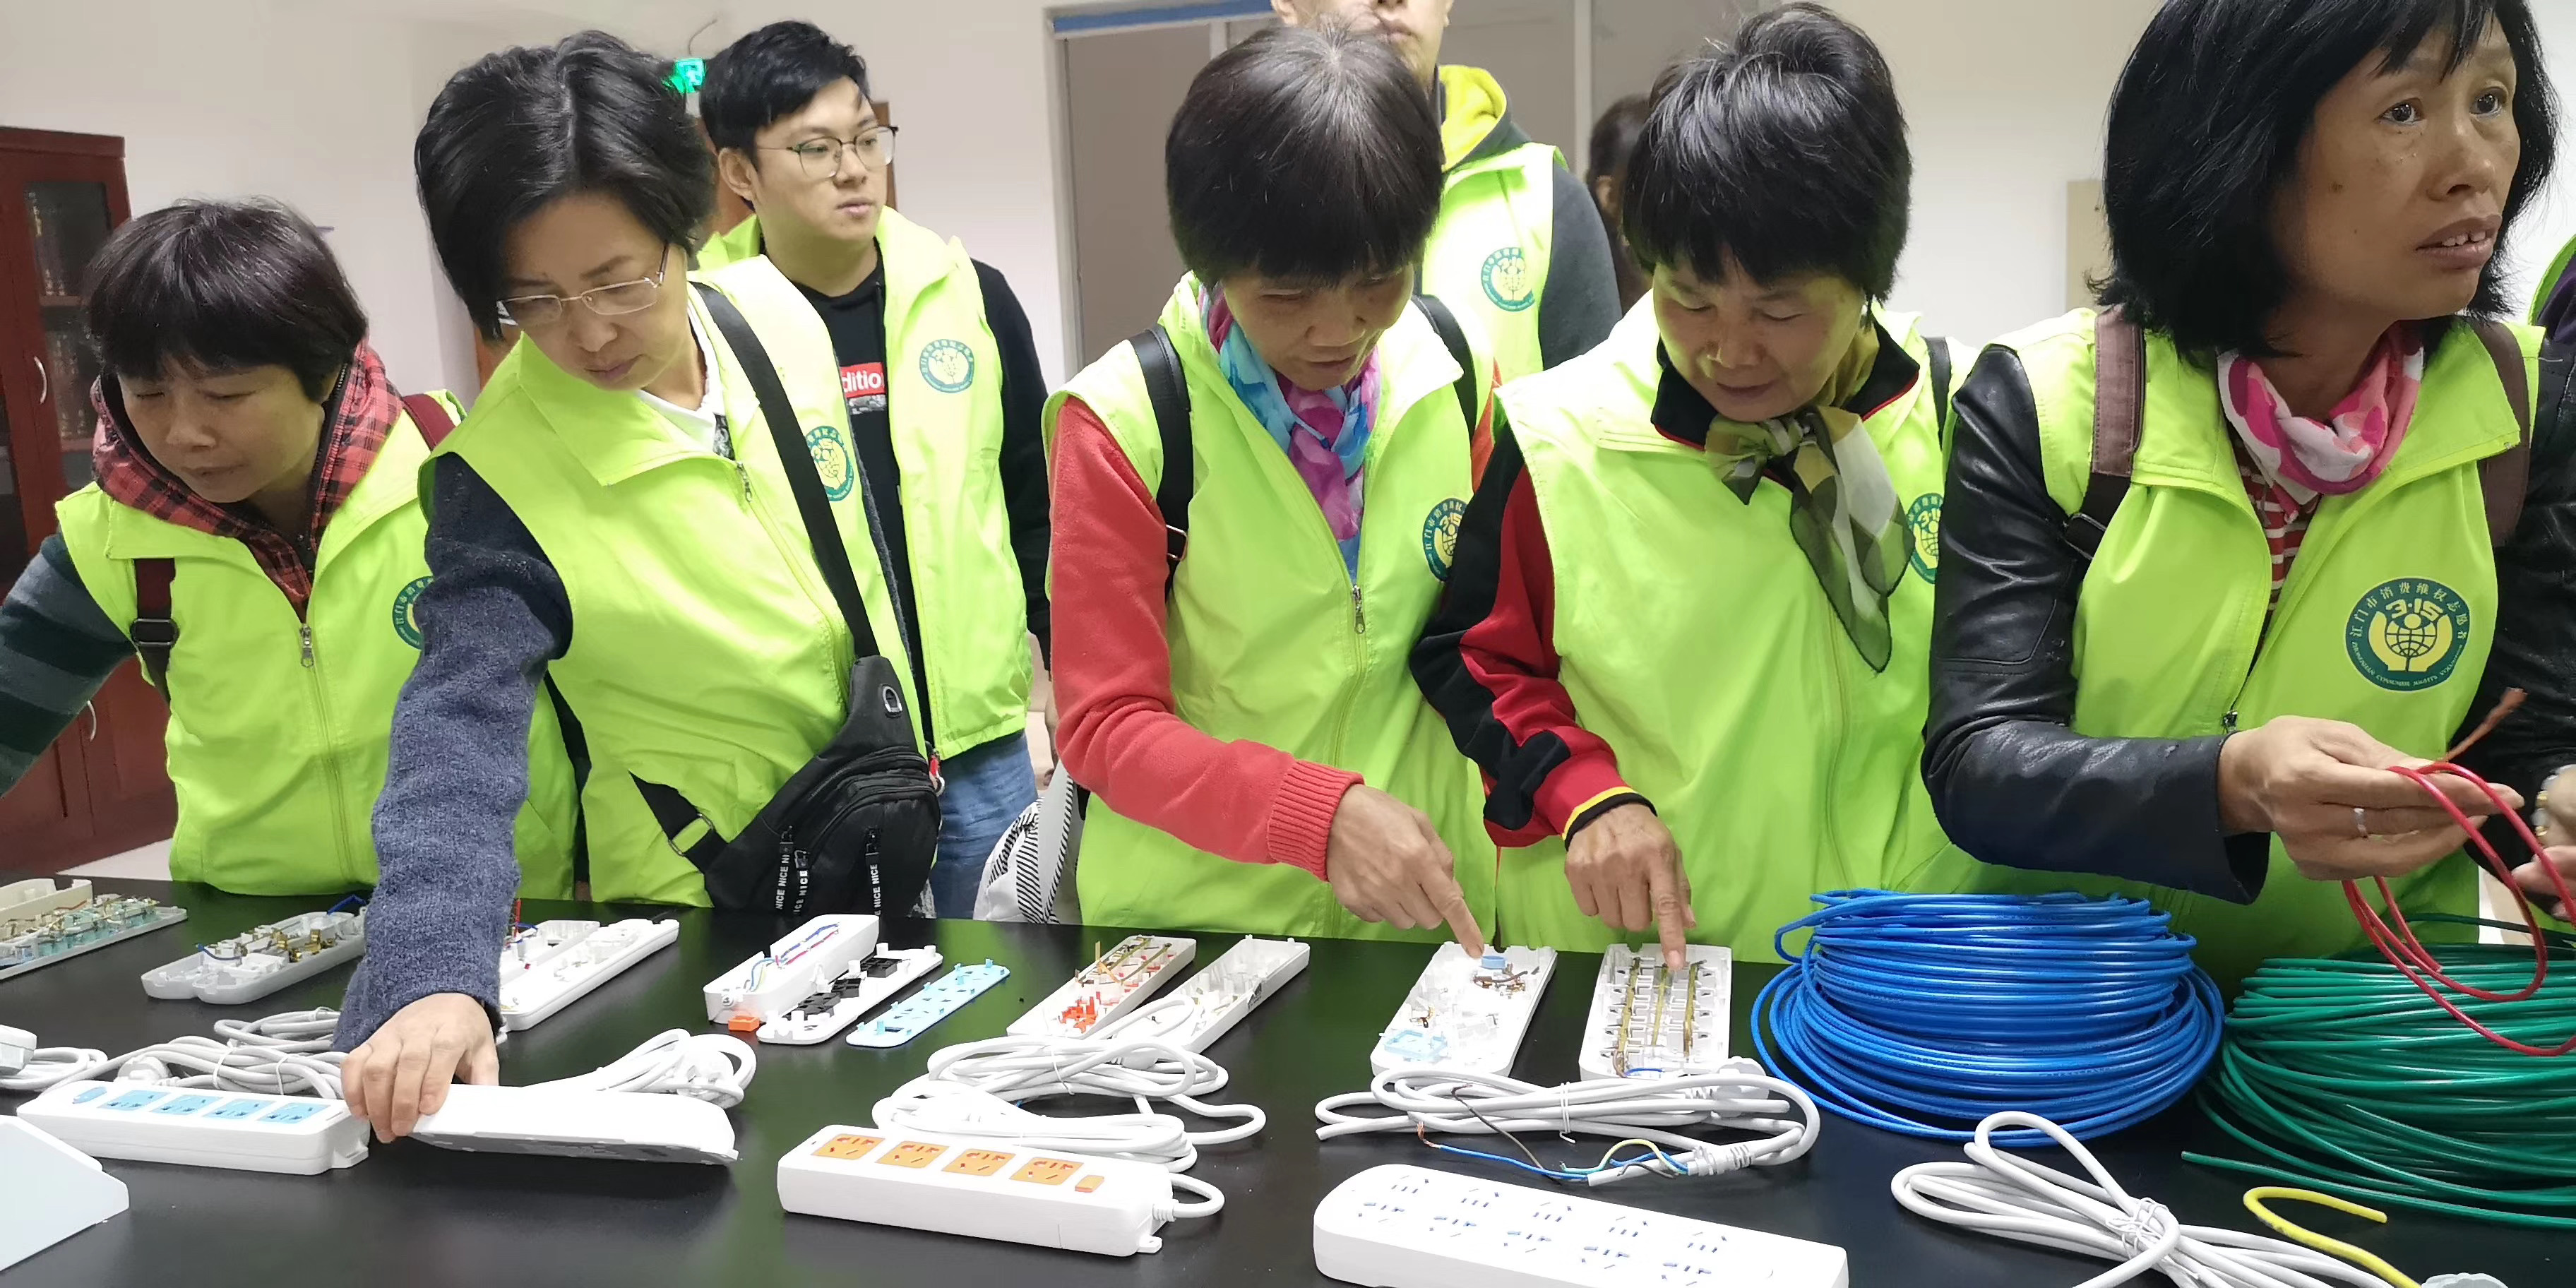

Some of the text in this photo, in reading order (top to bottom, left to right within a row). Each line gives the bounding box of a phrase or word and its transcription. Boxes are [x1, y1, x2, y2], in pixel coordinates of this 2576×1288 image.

[842, 370, 885, 393] ditio
[777, 866, 789, 887] NICE
[869, 864, 880, 885] NICE
[775, 888, 786, 910] NICE
[873, 886, 882, 908] NICE
